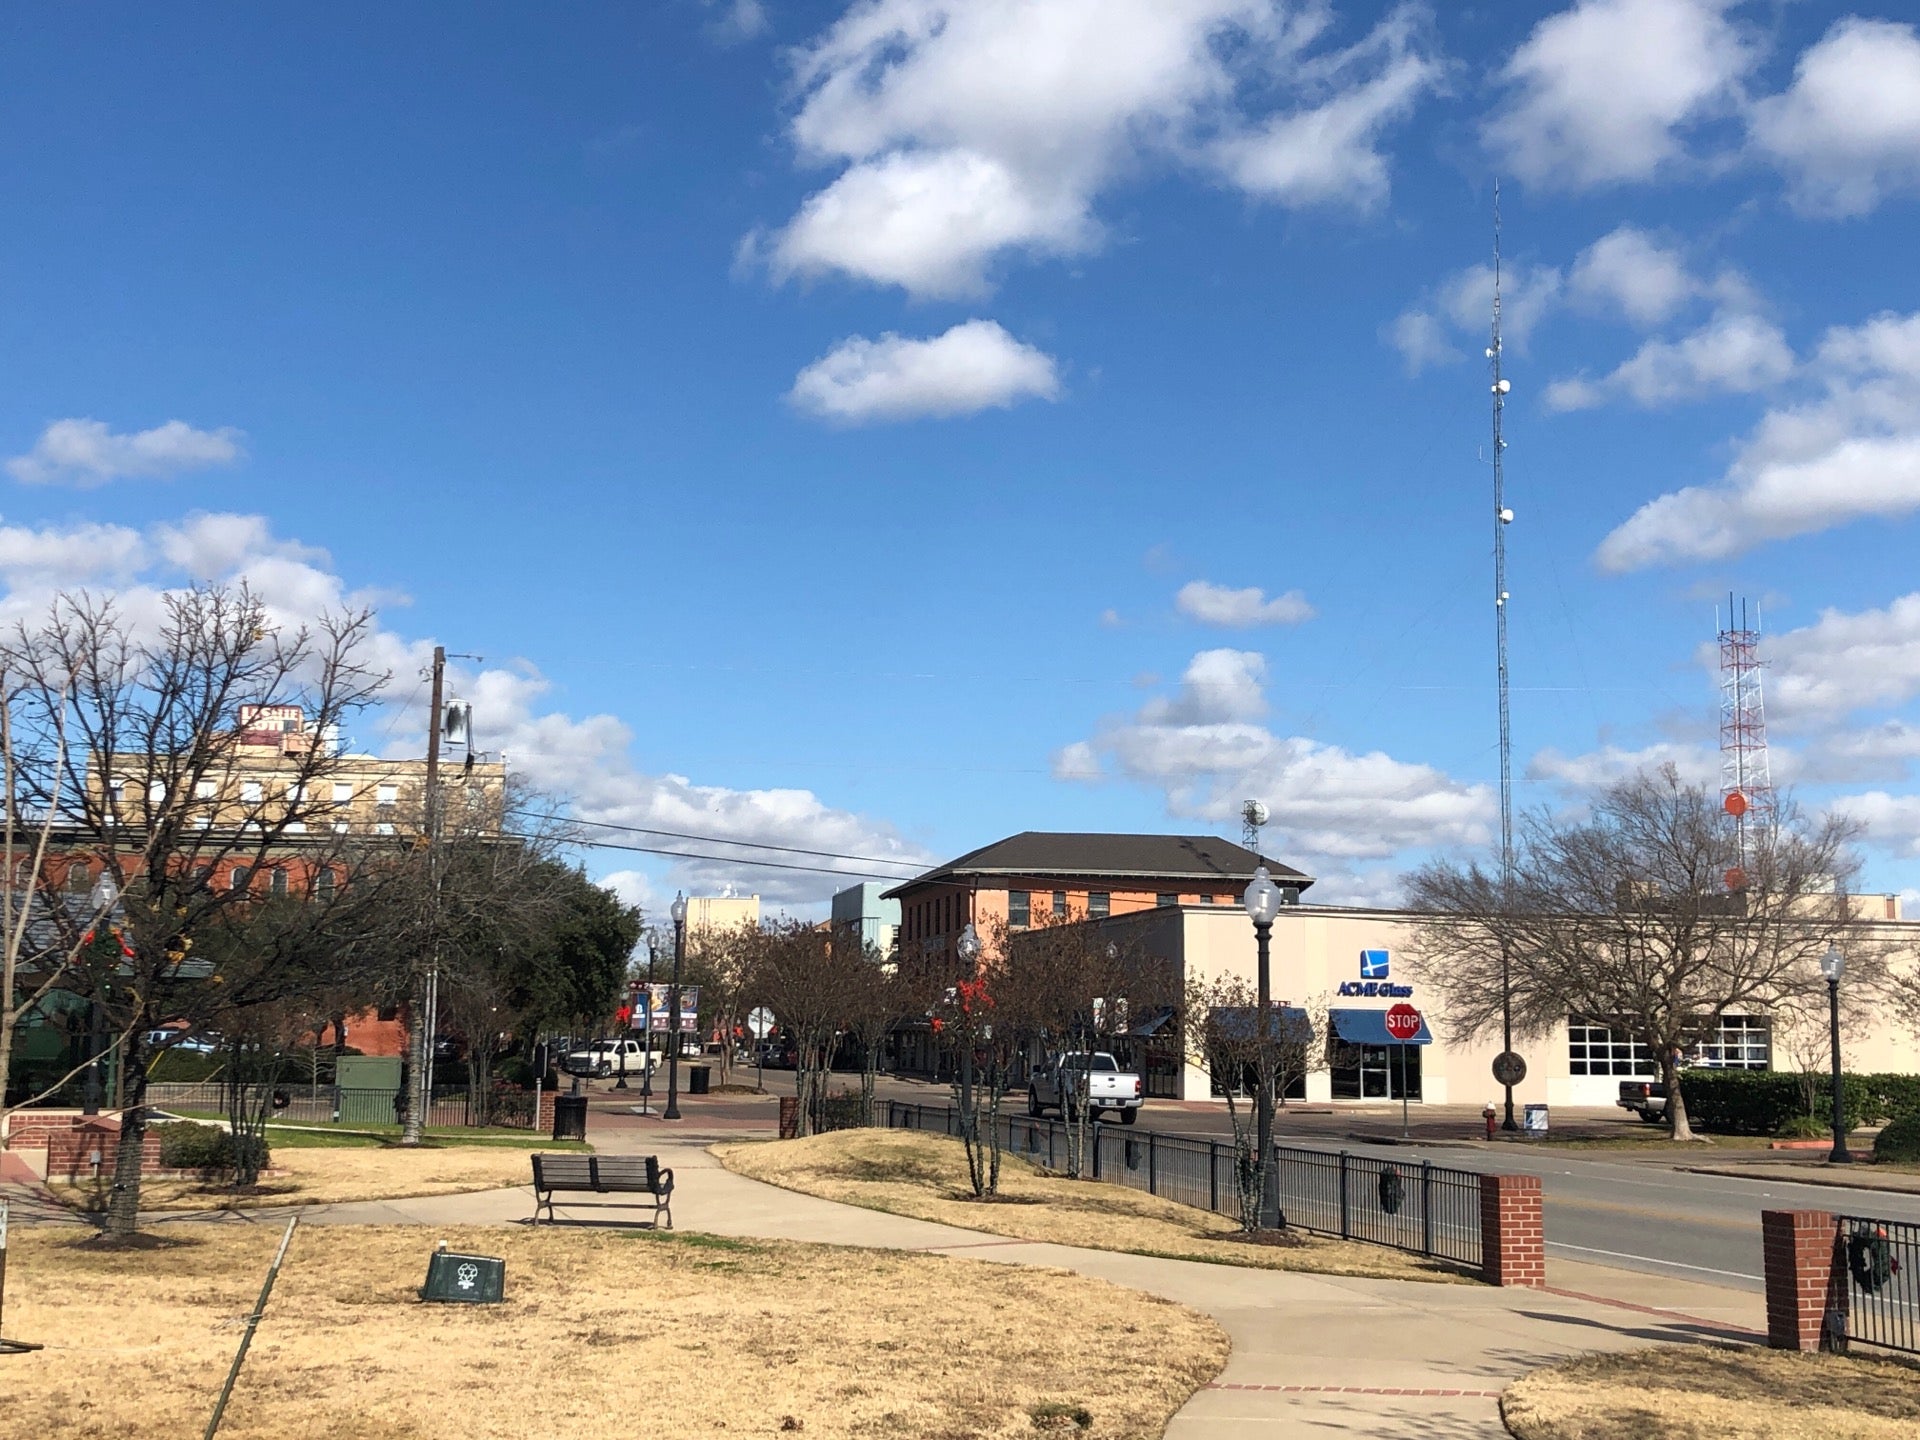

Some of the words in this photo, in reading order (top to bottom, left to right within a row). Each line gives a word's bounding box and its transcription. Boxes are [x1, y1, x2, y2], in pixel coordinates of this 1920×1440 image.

[1337, 981, 1378, 997] ACME
[1378, 982, 1413, 998] Glass
[1388, 1014, 1418, 1028] STOP
